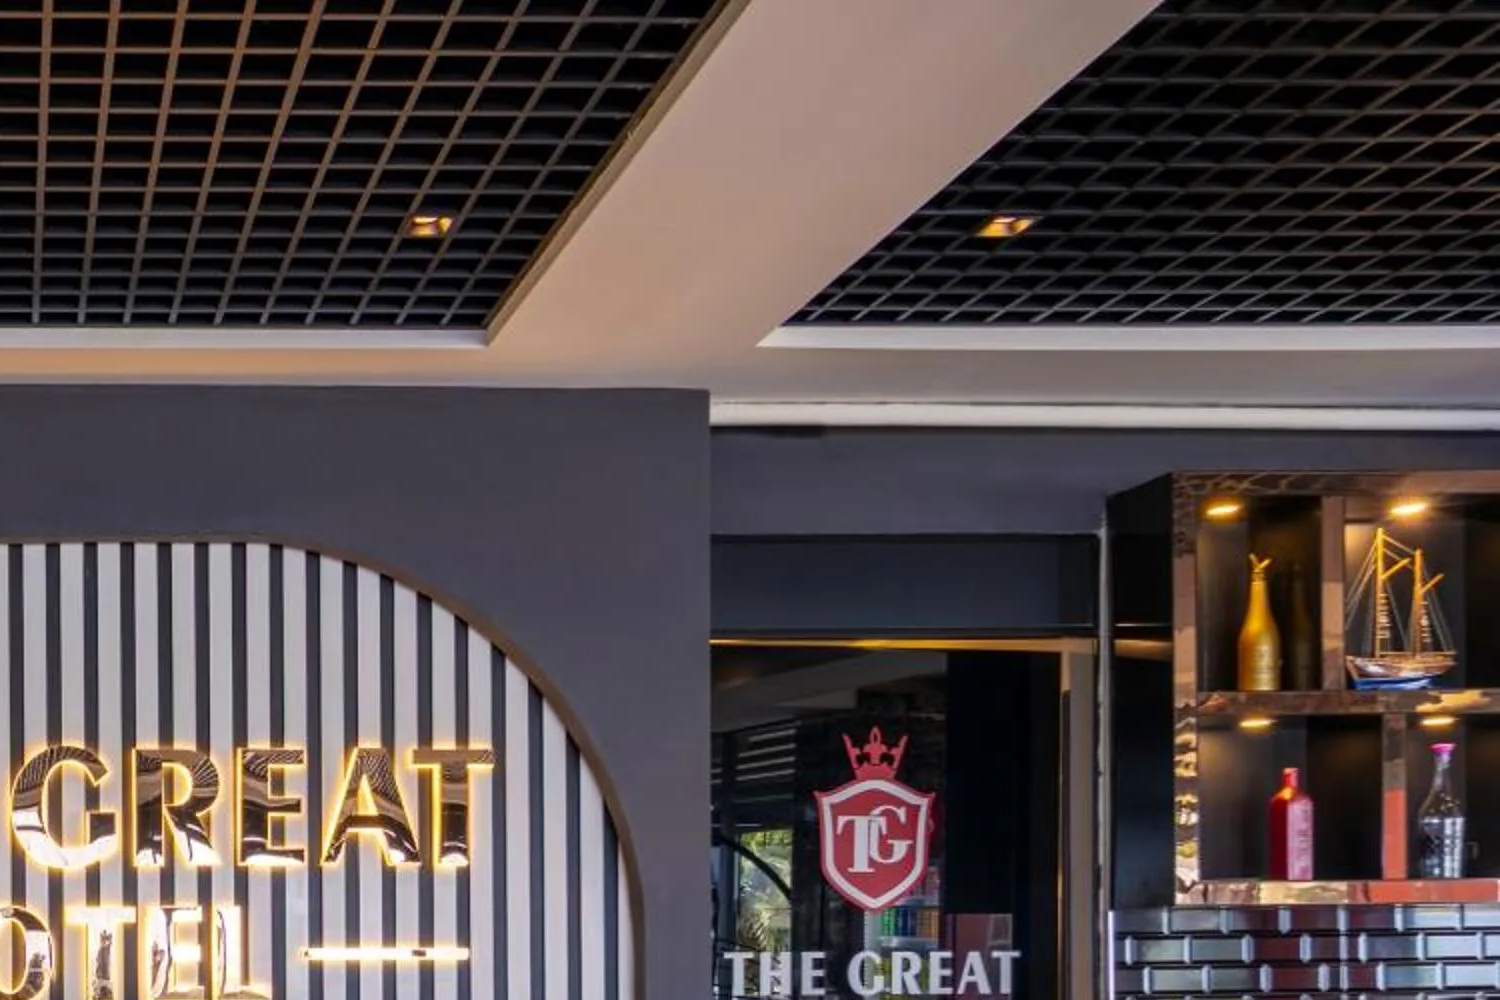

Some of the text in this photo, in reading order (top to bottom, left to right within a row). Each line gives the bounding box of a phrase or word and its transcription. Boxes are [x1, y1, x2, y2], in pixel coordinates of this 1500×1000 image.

[10, 745, 495, 869] GREAT
[723, 950, 1022, 997] THE GREAT
